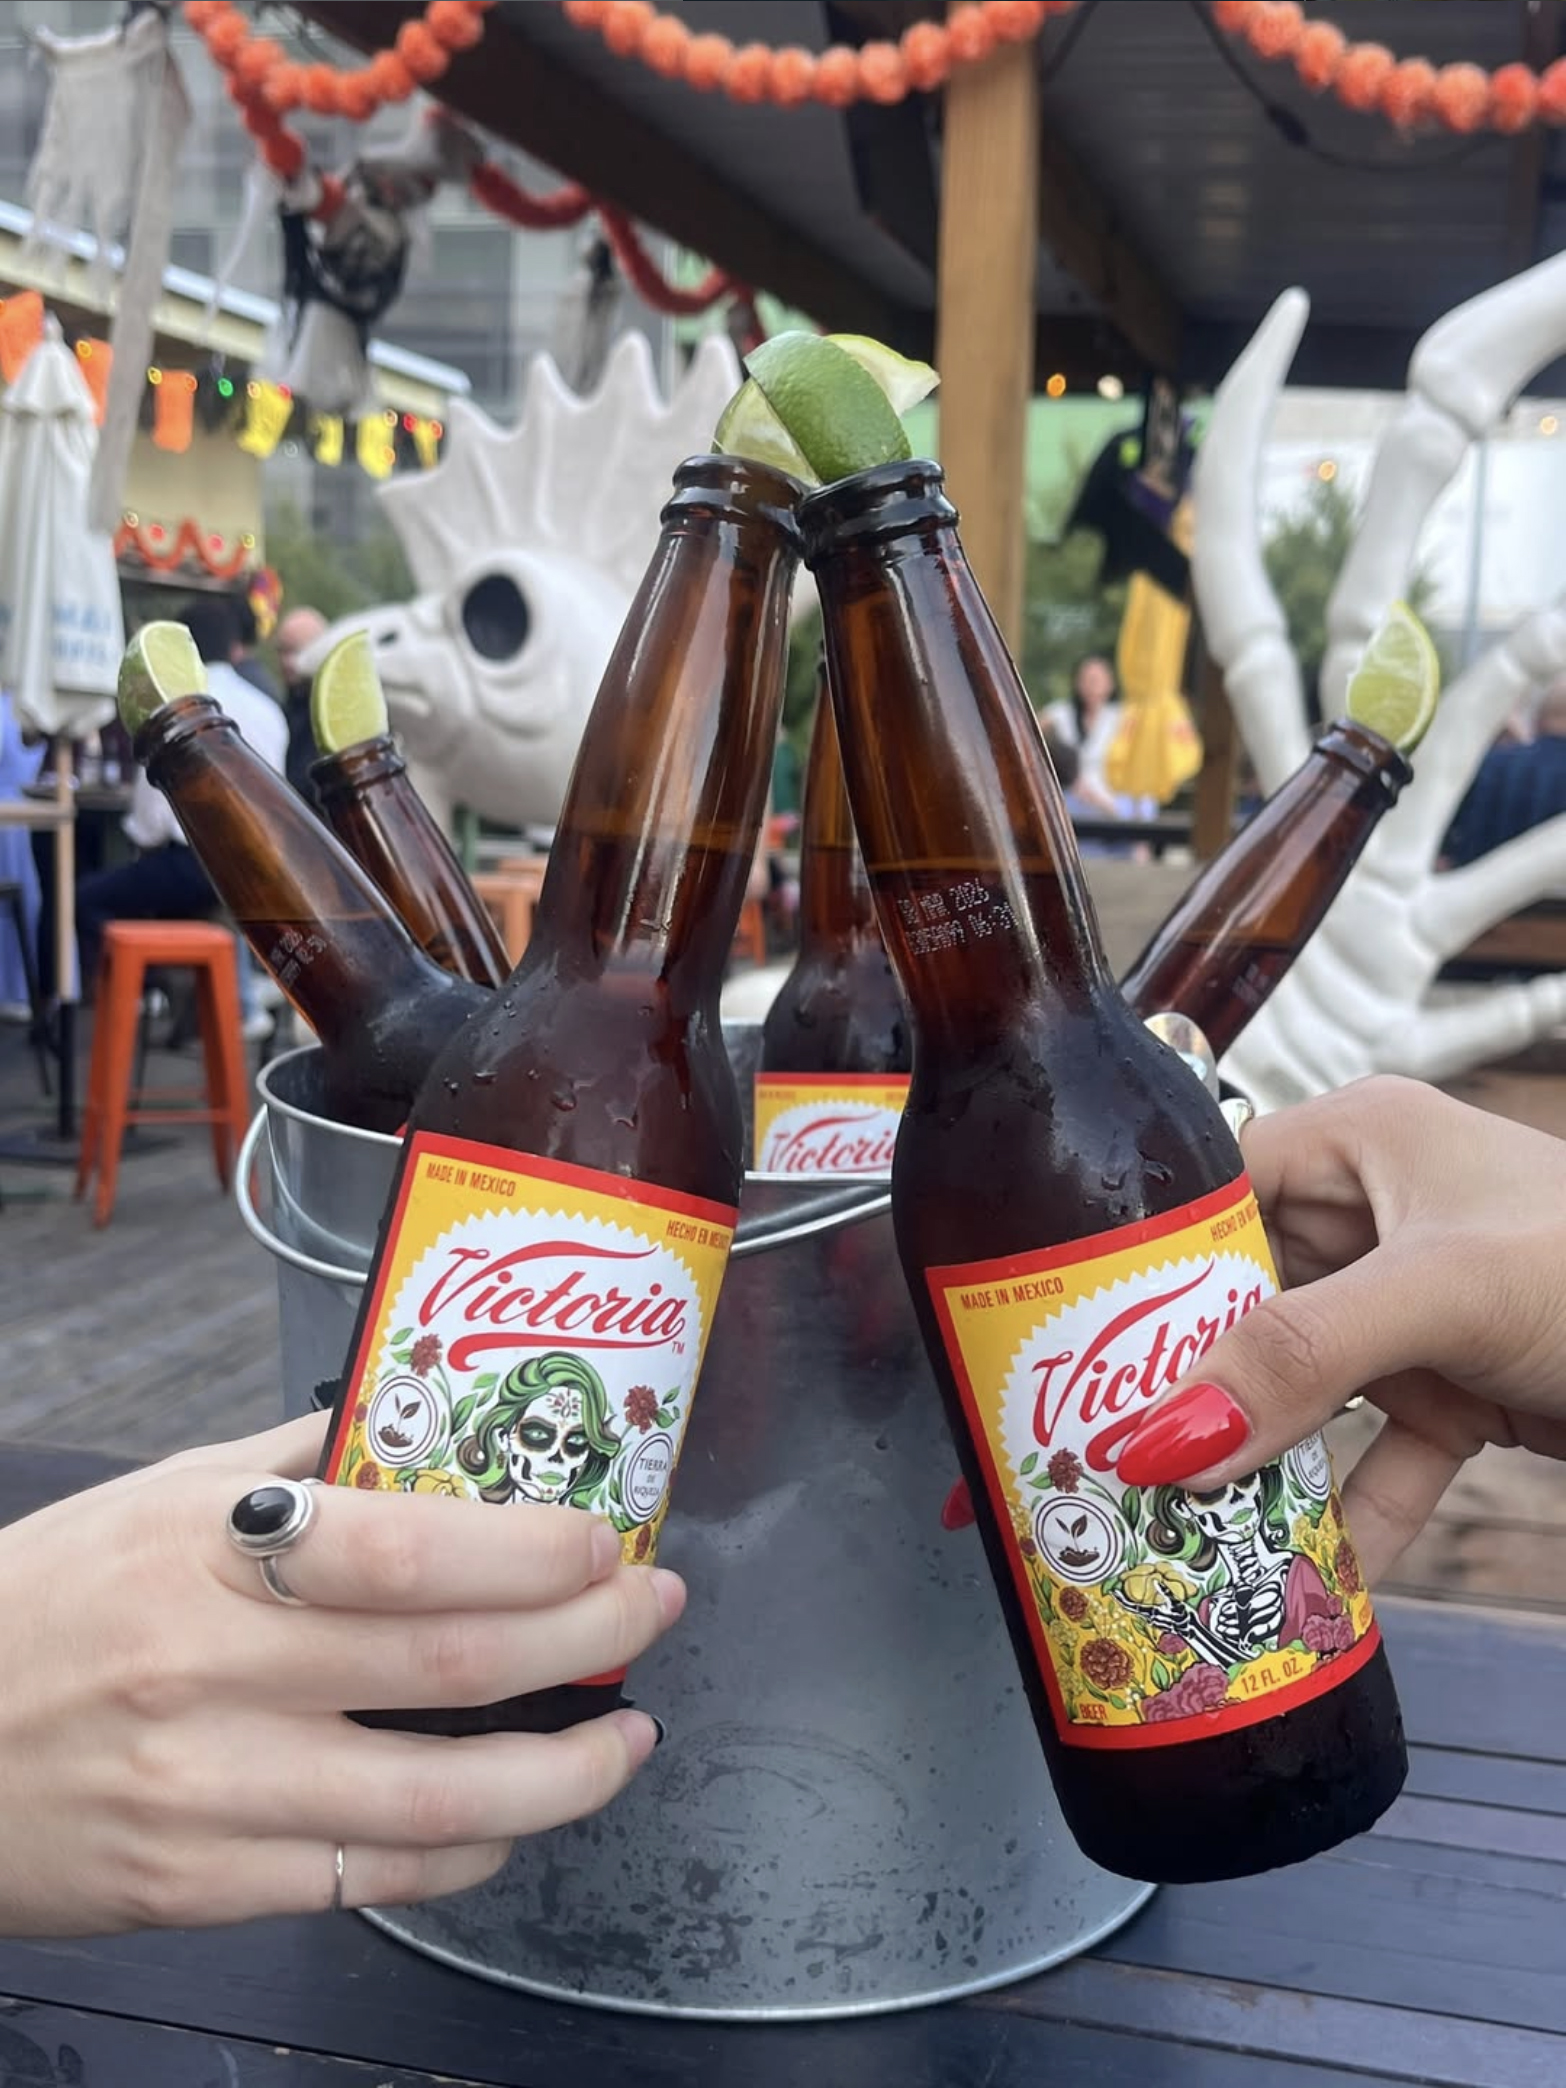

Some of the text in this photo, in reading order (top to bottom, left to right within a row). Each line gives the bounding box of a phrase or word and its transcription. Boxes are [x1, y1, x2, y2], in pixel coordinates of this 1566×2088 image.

[426, 1162, 517, 1197] MADE IN MEXICO
[666, 1219, 698, 1242] HECHO
[419, 1241, 687, 1337] Victoria
[961, 1276, 1065, 1310] MADE IN MEXICO
[639, 1457, 668, 1471] TIERRA
[1241, 1656, 1304, 1694] 12 FL. OZ.
[1080, 1703, 1107, 1719] BEER
